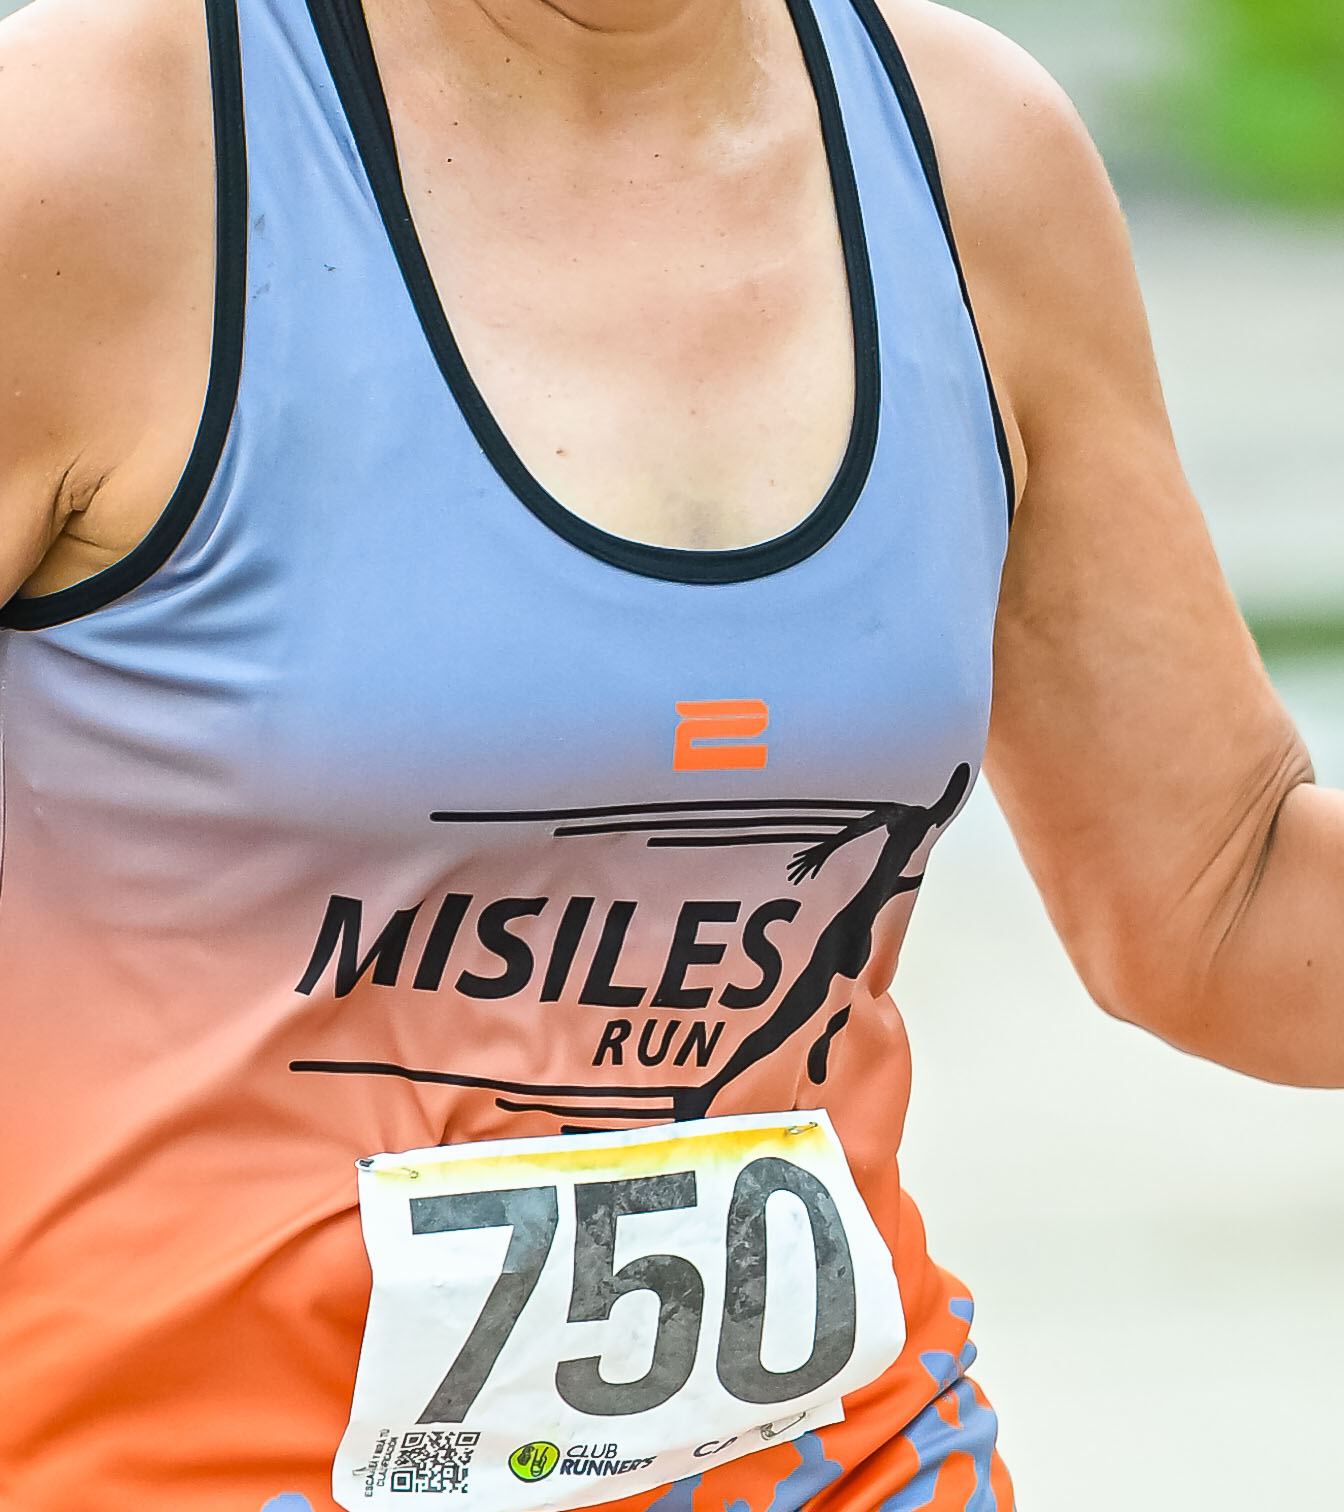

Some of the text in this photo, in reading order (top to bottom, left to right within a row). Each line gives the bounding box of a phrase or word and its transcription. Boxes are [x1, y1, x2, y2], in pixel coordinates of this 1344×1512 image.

[294, 893, 802, 1009] MISILES
[593, 1019, 725, 1068] RUN
[409, 1157, 856, 1424] 750
[567, 1444, 617, 1458] CLUB
